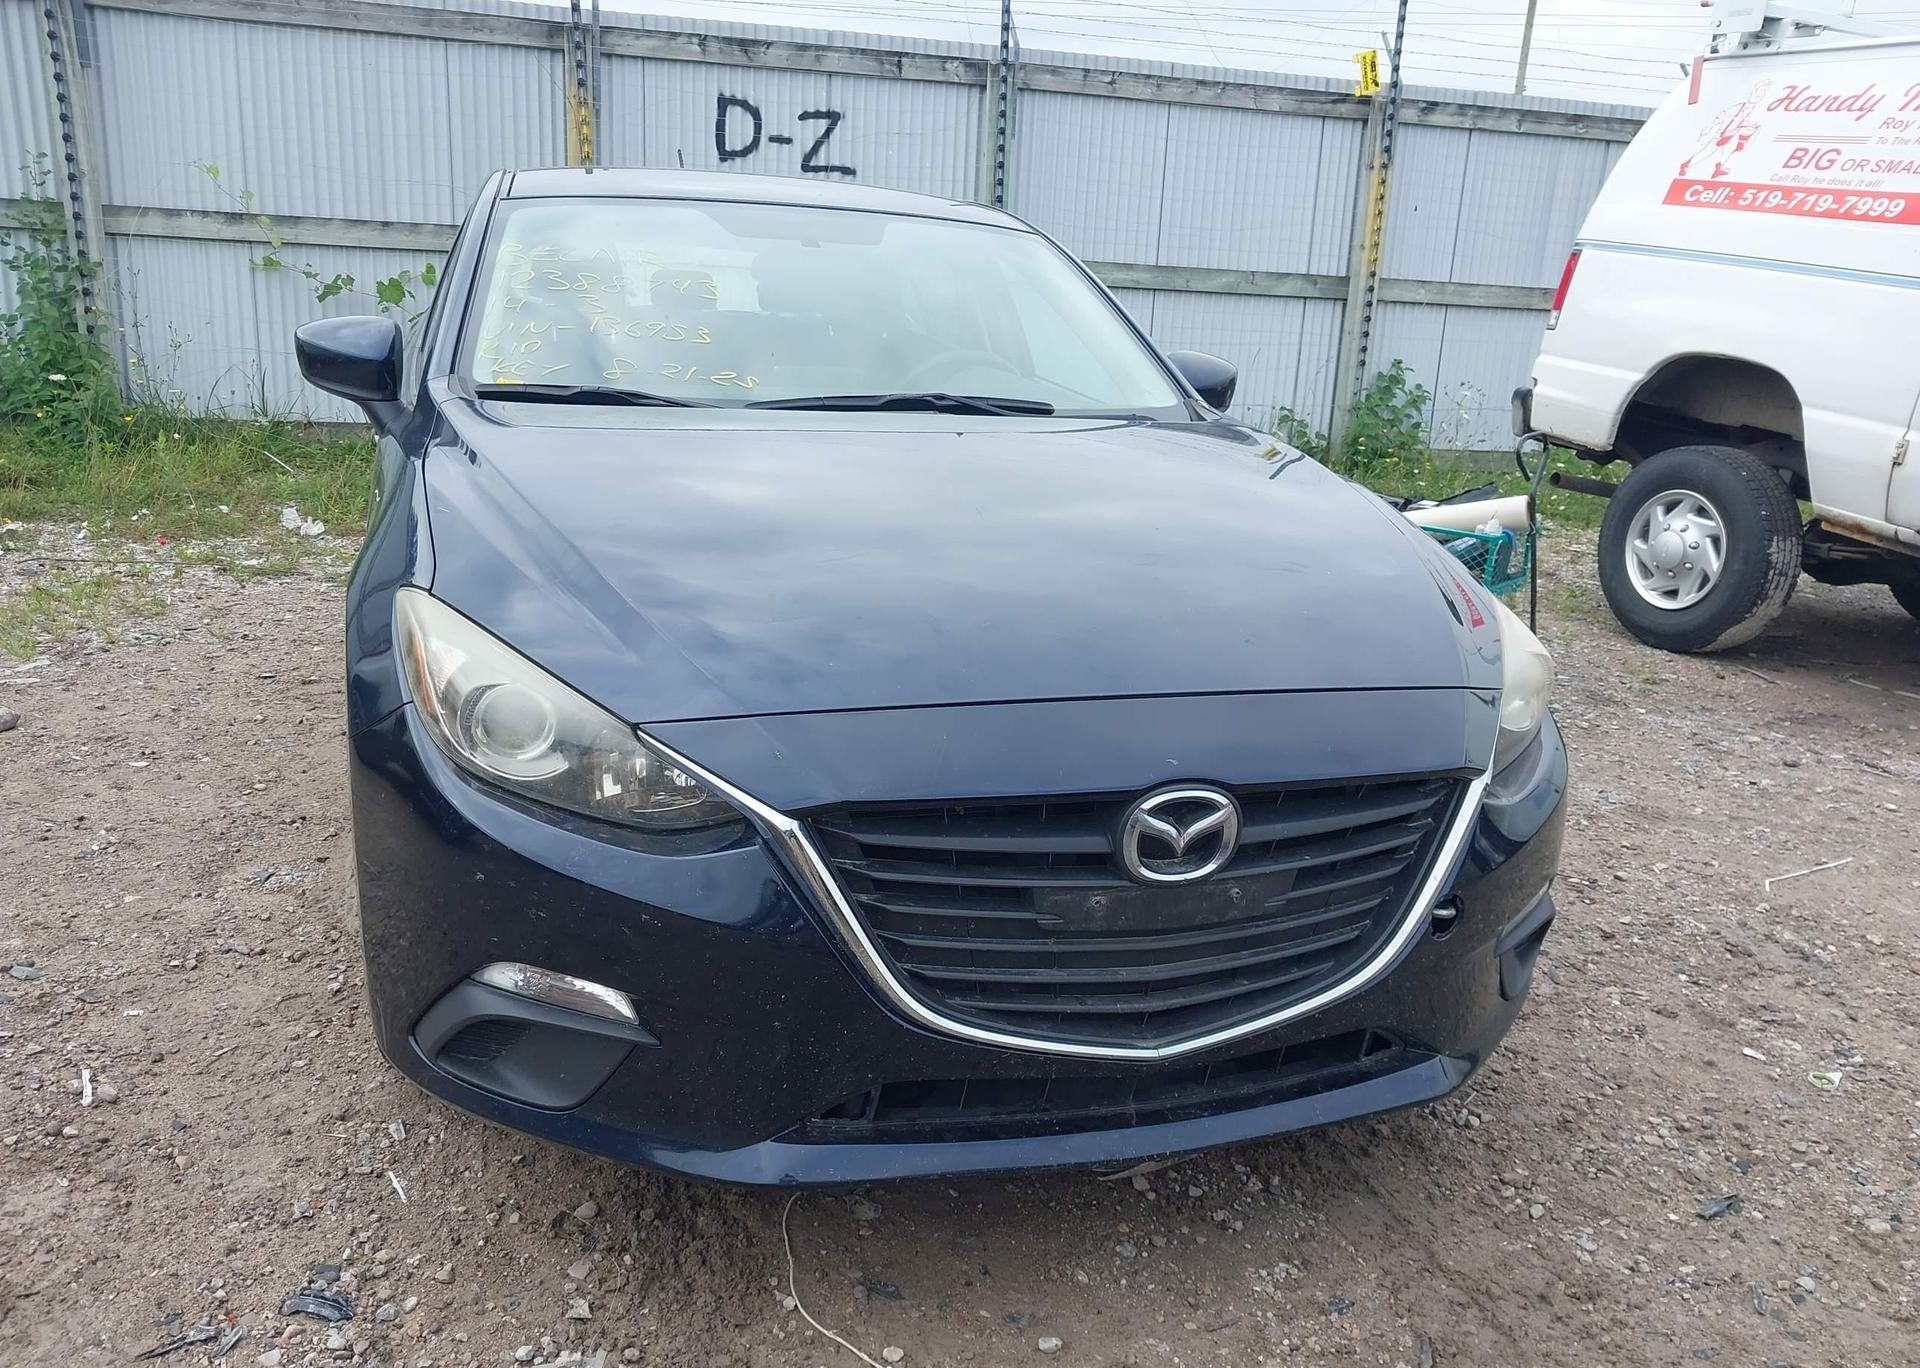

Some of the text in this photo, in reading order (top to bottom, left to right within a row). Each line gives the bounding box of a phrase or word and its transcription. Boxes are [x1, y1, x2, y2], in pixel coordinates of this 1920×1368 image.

[1766, 83, 1887, 122] Handy
[715, 92, 856, 176] D-Z
[1878, 117, 1916, 133] Roy
[1876, 136, 1889, 146] To
[1891, 136, 1912, 147] The
[1782, 147, 1842, 171] BIG
[1840, 158, 1871, 172] OR
[1790, 174, 1810, 186] Roy
[1811, 176, 1826, 185] he
[1827, 178, 1852, 187] does
[1684, 184, 1906, 218] Cell: 519-719-7999
